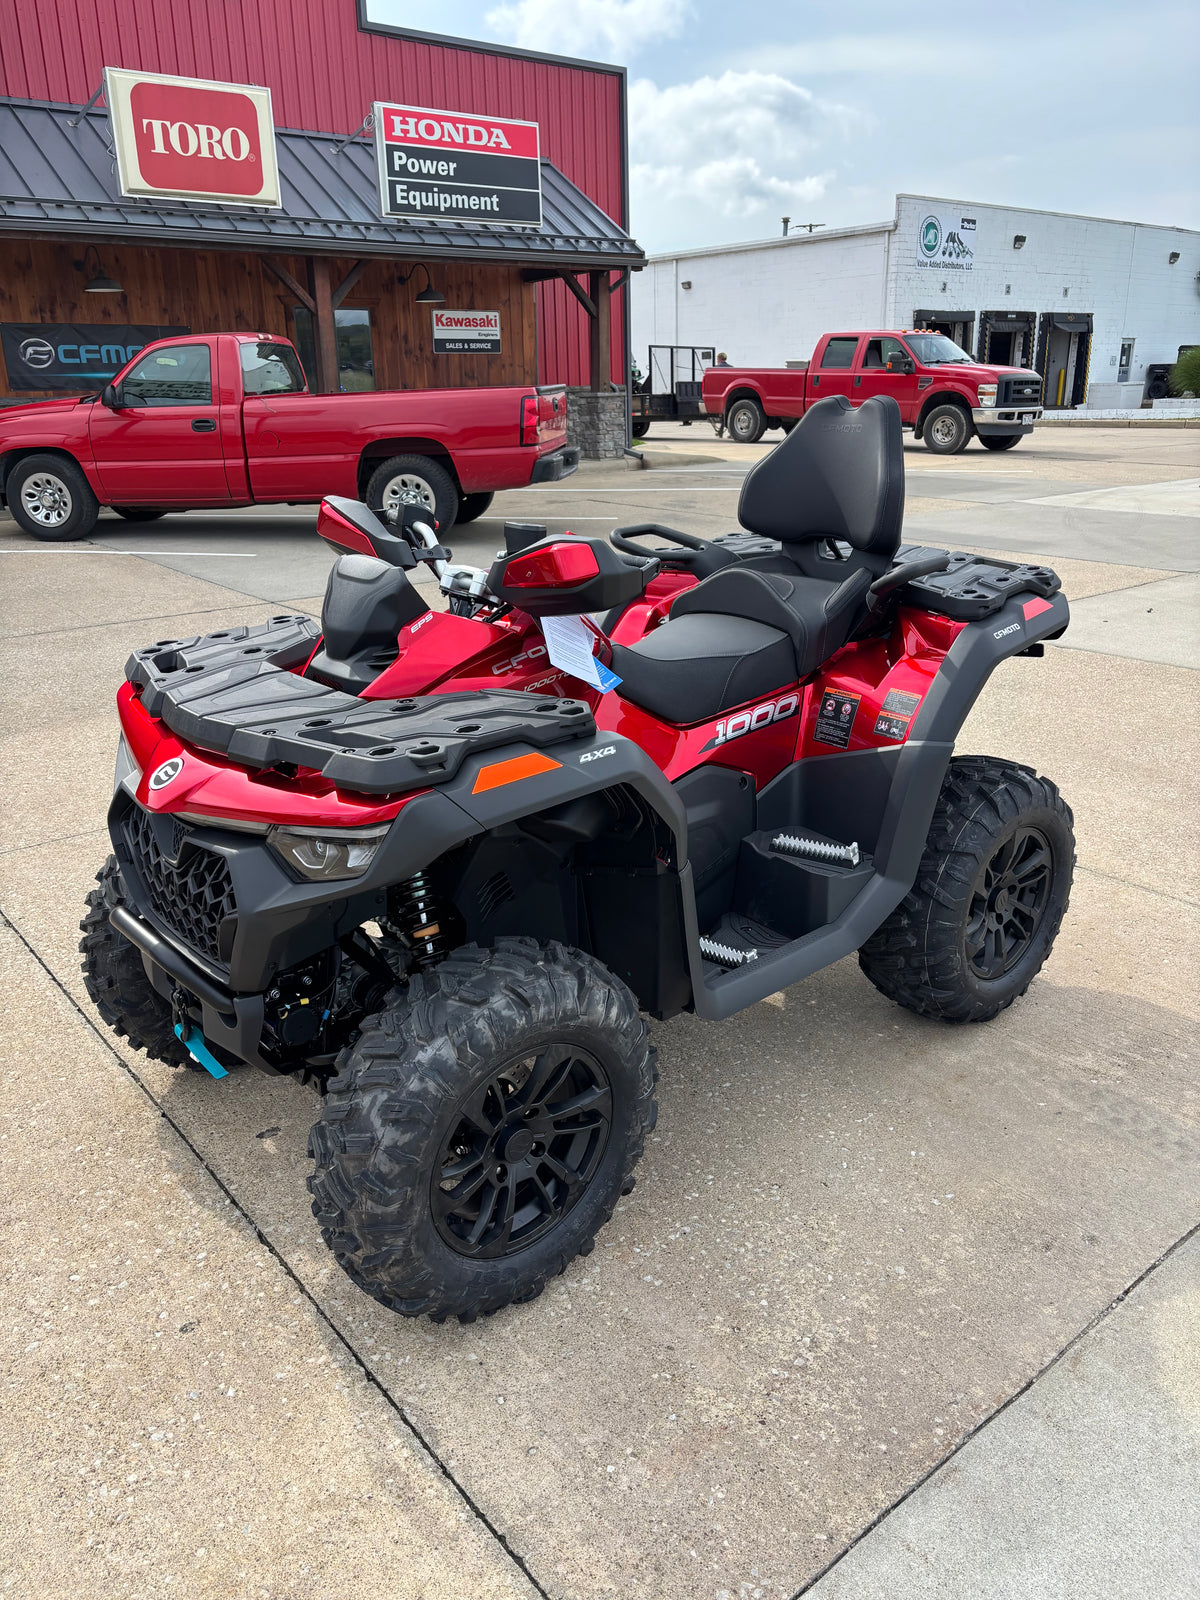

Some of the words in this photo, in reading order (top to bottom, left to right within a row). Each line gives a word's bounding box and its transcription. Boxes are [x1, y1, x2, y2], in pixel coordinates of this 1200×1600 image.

[142, 118, 250, 161] TORO
[390, 115, 512, 149] HONDA
[393, 151, 457, 176] Power
[395, 184, 500, 212] Equipment
[917, 260, 928, 268] Value
[929, 260, 942, 269] Added
[435, 313, 498, 328] Kawasaki
[410, 612, 434, 634] EPS
[993, 623, 1021, 640] CFMOTO
[714, 692, 800, 745] 1000
